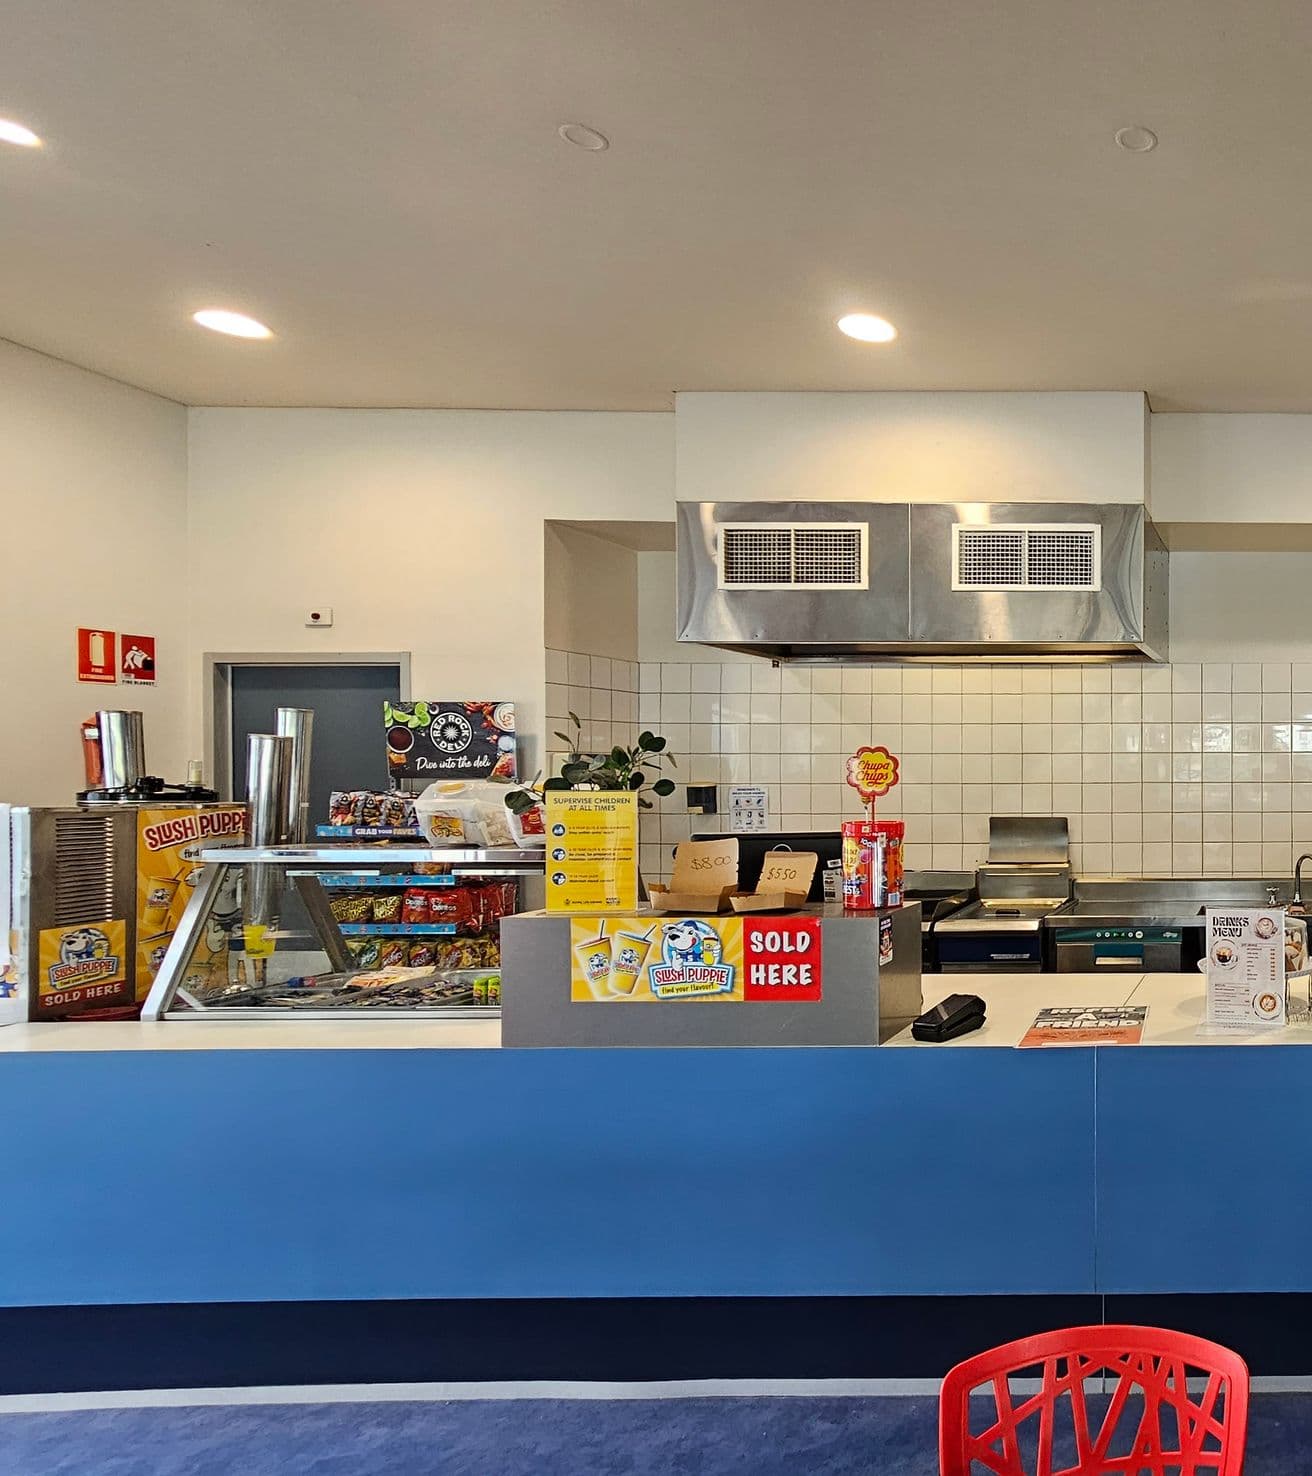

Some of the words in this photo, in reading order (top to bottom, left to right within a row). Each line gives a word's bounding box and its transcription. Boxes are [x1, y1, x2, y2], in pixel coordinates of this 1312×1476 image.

[432, 717, 448, 737] RED
[448, 714, 470, 737] ROCK
[439, 740, 466, 751] DELI
[415, 756, 438, 771] Dive
[439, 757, 456, 768] into
[456, 755, 472, 768] the
[473, 754, 491, 767] deli
[858, 760, 890, 772] Chupa
[856, 770, 889, 787] Chups
[143, 817, 196, 850] SLUSH
[432, 903, 457, 912] Doritos
[1212, 916, 1250, 927] DRINKS
[1212, 927, 1243, 938] MENU
[750, 931, 811, 953] SOLD
[655, 968, 685, 983] SLUSH
[750, 964, 812, 986] HERE
[45, 991, 81, 1006] SOLD
[86, 982, 121, 998] HERE
[662, 986, 675, 994] find
[1035, 1020, 1141, 1029] FRIEND
